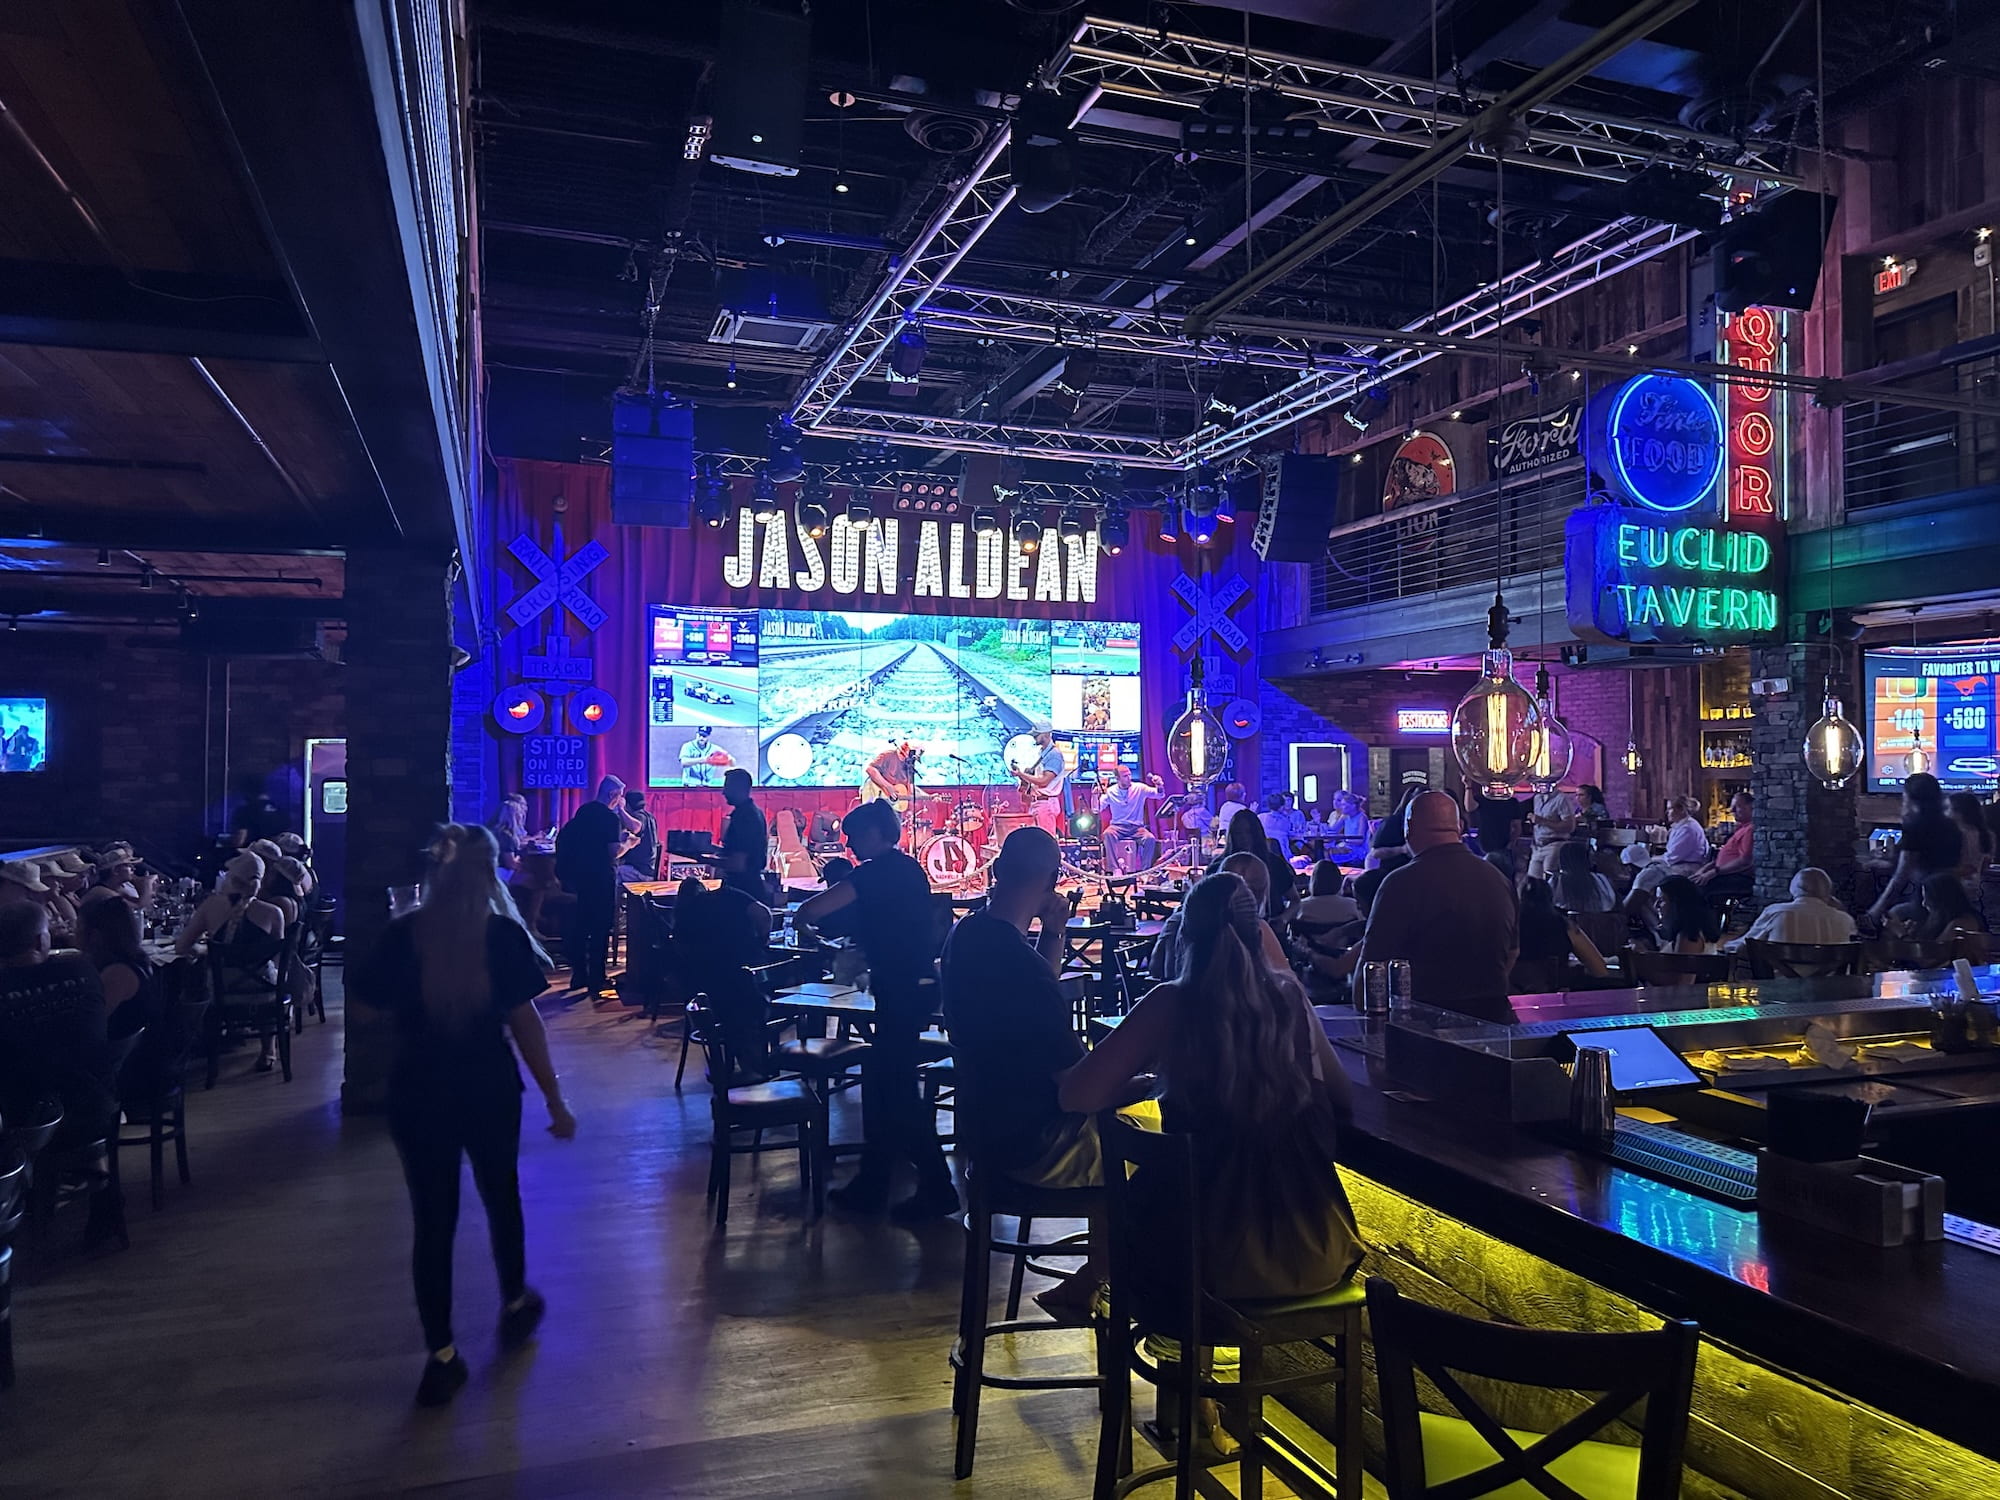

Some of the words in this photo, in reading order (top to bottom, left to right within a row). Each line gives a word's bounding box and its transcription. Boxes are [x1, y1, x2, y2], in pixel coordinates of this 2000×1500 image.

[1879, 266, 1902, 292] EXIT
[1738, 307, 1775, 513] QUOR
[1494, 404, 1584, 468] Ford
[1509, 449, 1570, 474] AUTHORIZED
[1627, 437, 1708, 474] FOOD
[723, 507, 899, 595] JASON
[914, 520, 1097, 603] ALDEAN
[1618, 524, 1771, 573] EUCLID
[514, 541, 547, 579] RAIL
[563, 588, 602, 626] ROAD
[1616, 584, 1777, 630] TAVERN
[1215, 616, 1244, 648] ROAD
[533, 662, 584, 675] TRACK
[1922, 662, 1973, 677] FAVORITES
[1974, 661, 1988, 674] TO
[1399, 714, 1448, 728] RESTROOMS
[530, 739, 583, 755] STOP
[528, 759, 547, 770] ON
[556, 760, 584, 770] RED
[527, 774, 587, 785] SIGNAL
